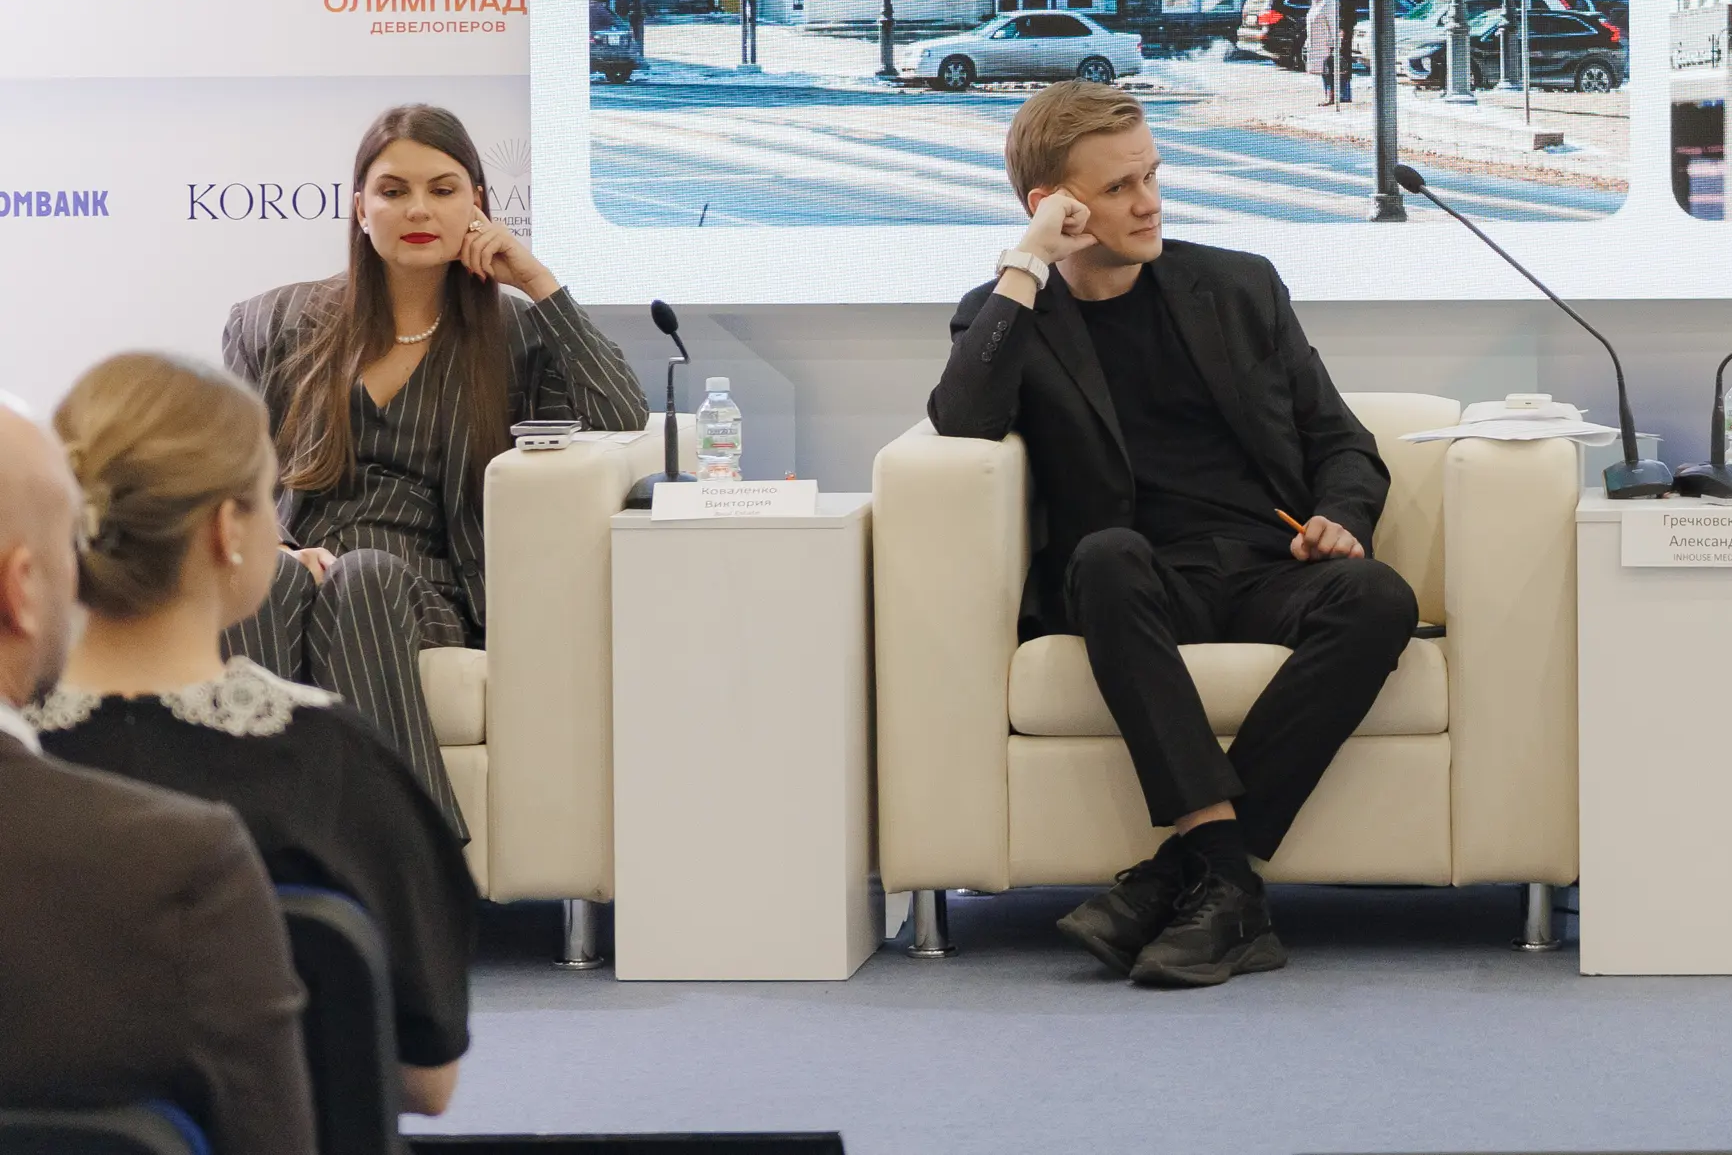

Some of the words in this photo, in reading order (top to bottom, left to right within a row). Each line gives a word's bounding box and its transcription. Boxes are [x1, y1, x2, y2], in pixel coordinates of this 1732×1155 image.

[370, 20, 507, 35] ДЕВЕЛОПЕРОВ
[701, 487, 778, 496] Коваленко
[704, 499, 772, 509] Виктория
[1673, 553, 1711, 562] INHOUSE
